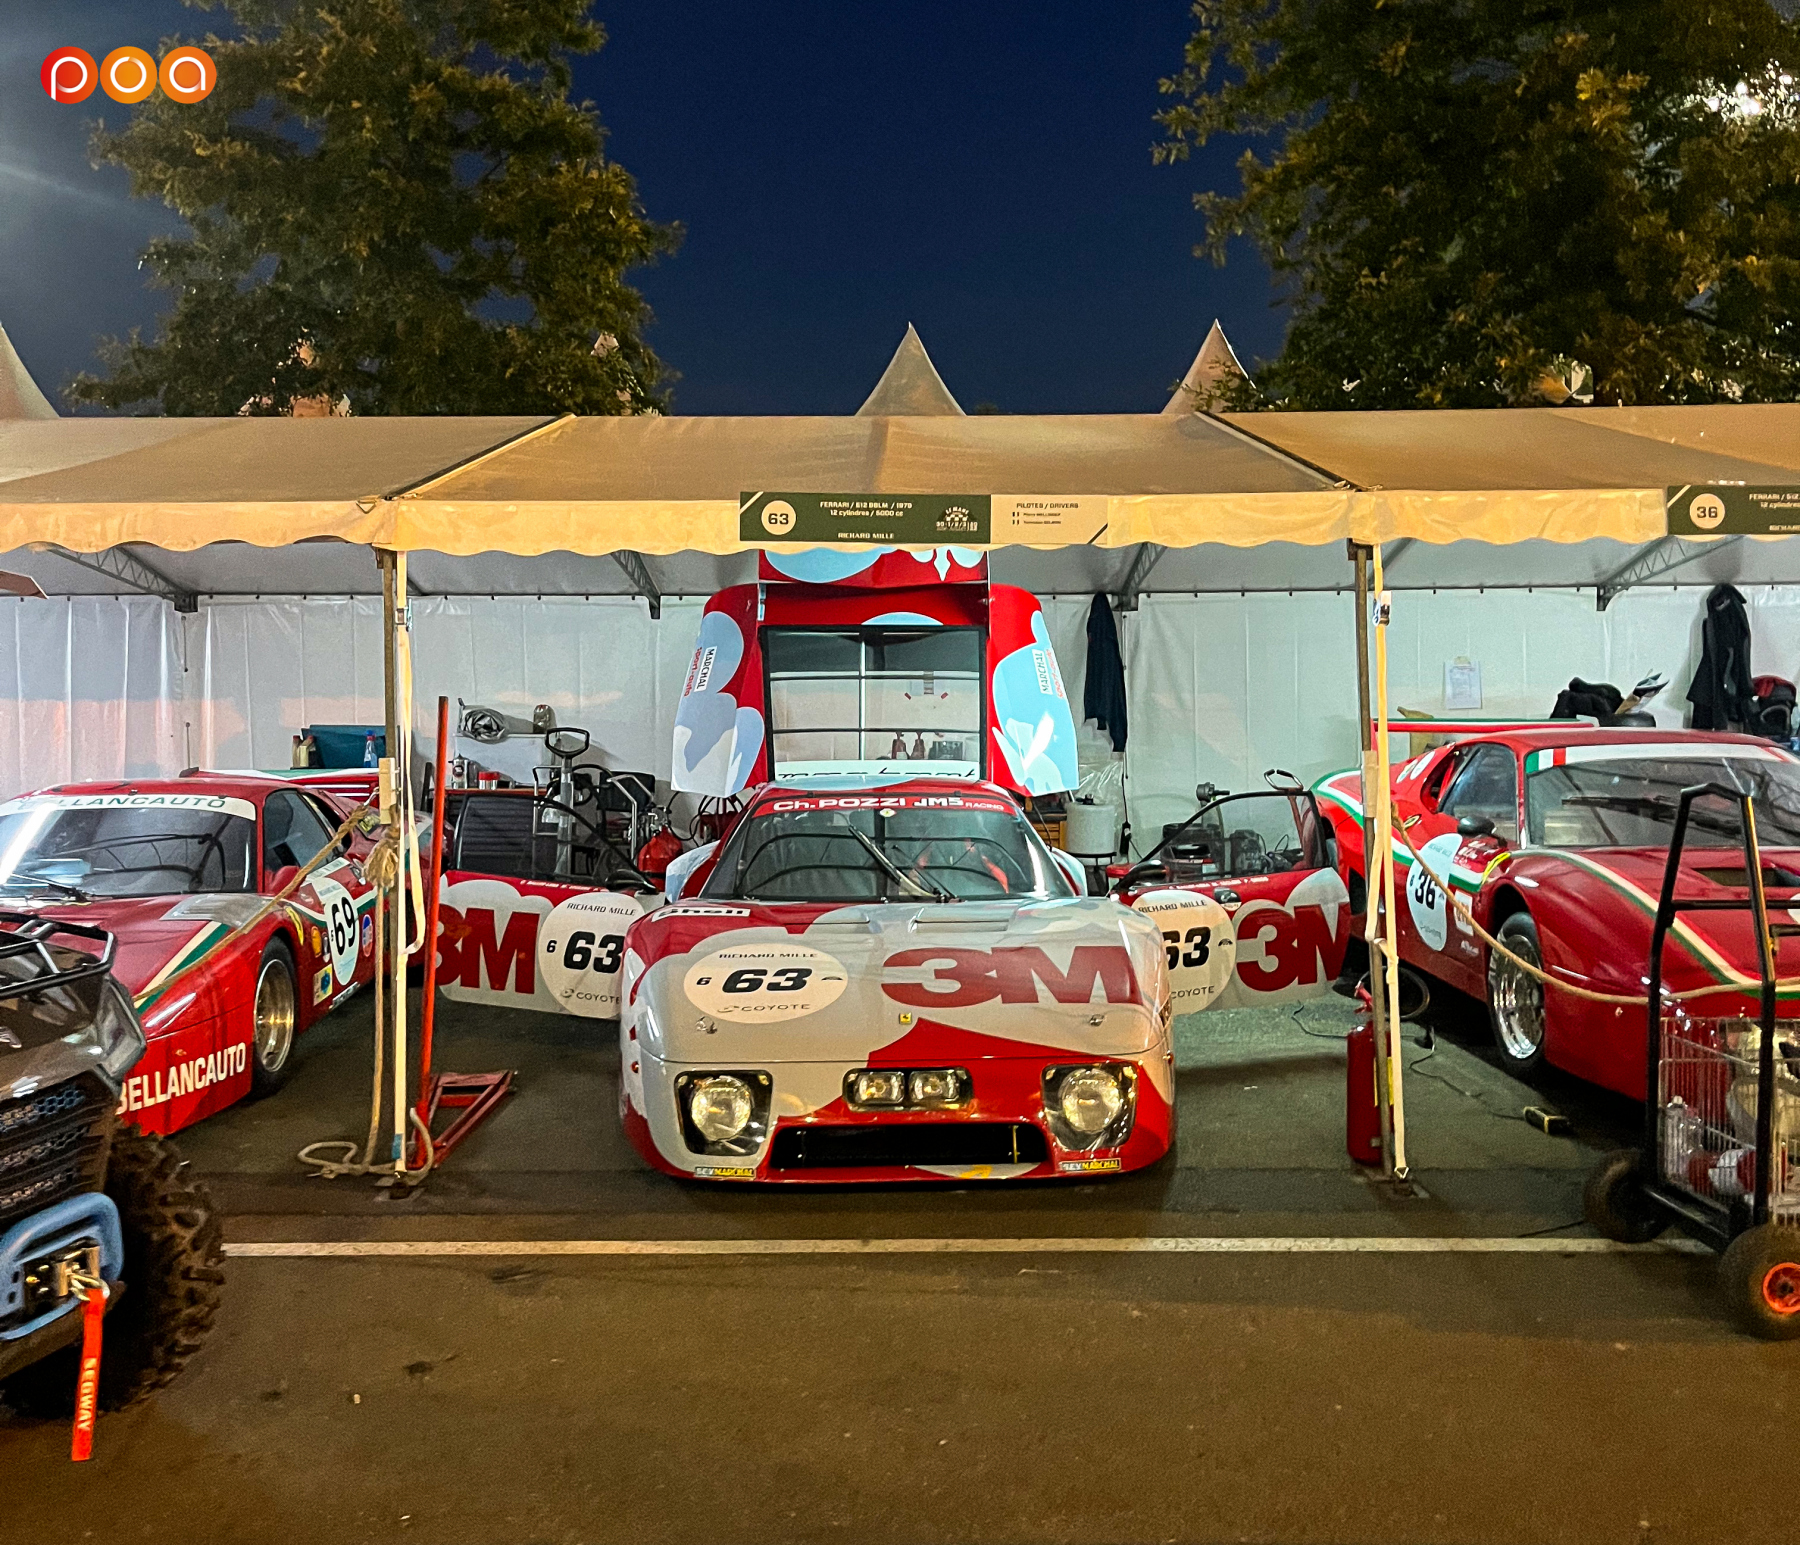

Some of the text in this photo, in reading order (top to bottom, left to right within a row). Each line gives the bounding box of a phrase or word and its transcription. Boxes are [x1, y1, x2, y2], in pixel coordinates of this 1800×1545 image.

[1696, 506, 1718, 518] 36
[768, 513, 790, 525] 63
[696, 648, 715, 690] MARCHAL
[1035, 652, 1050, 692] MARCHAL
[817, 798, 906, 807] POZZI
[965, 802, 1004, 810] RACING
[567, 903, 636, 916] RICHARD MILLE
[1138, 899, 1208, 913] RICHARD MILLE
[332, 897, 356, 956] 69
[546, 940, 558, 953] 6
[563, 931, 625, 974] 63
[1236, 902, 1351, 991] 3M
[696, 977, 712, 986] 6
[722, 968, 813, 994] 63
[881, 946, 1143, 1008] 3M
[576, 992, 620, 1004] COYOTE
[1170, 986, 1215, 999] COYOTE
[741, 1004, 812, 1012] COYOTE
